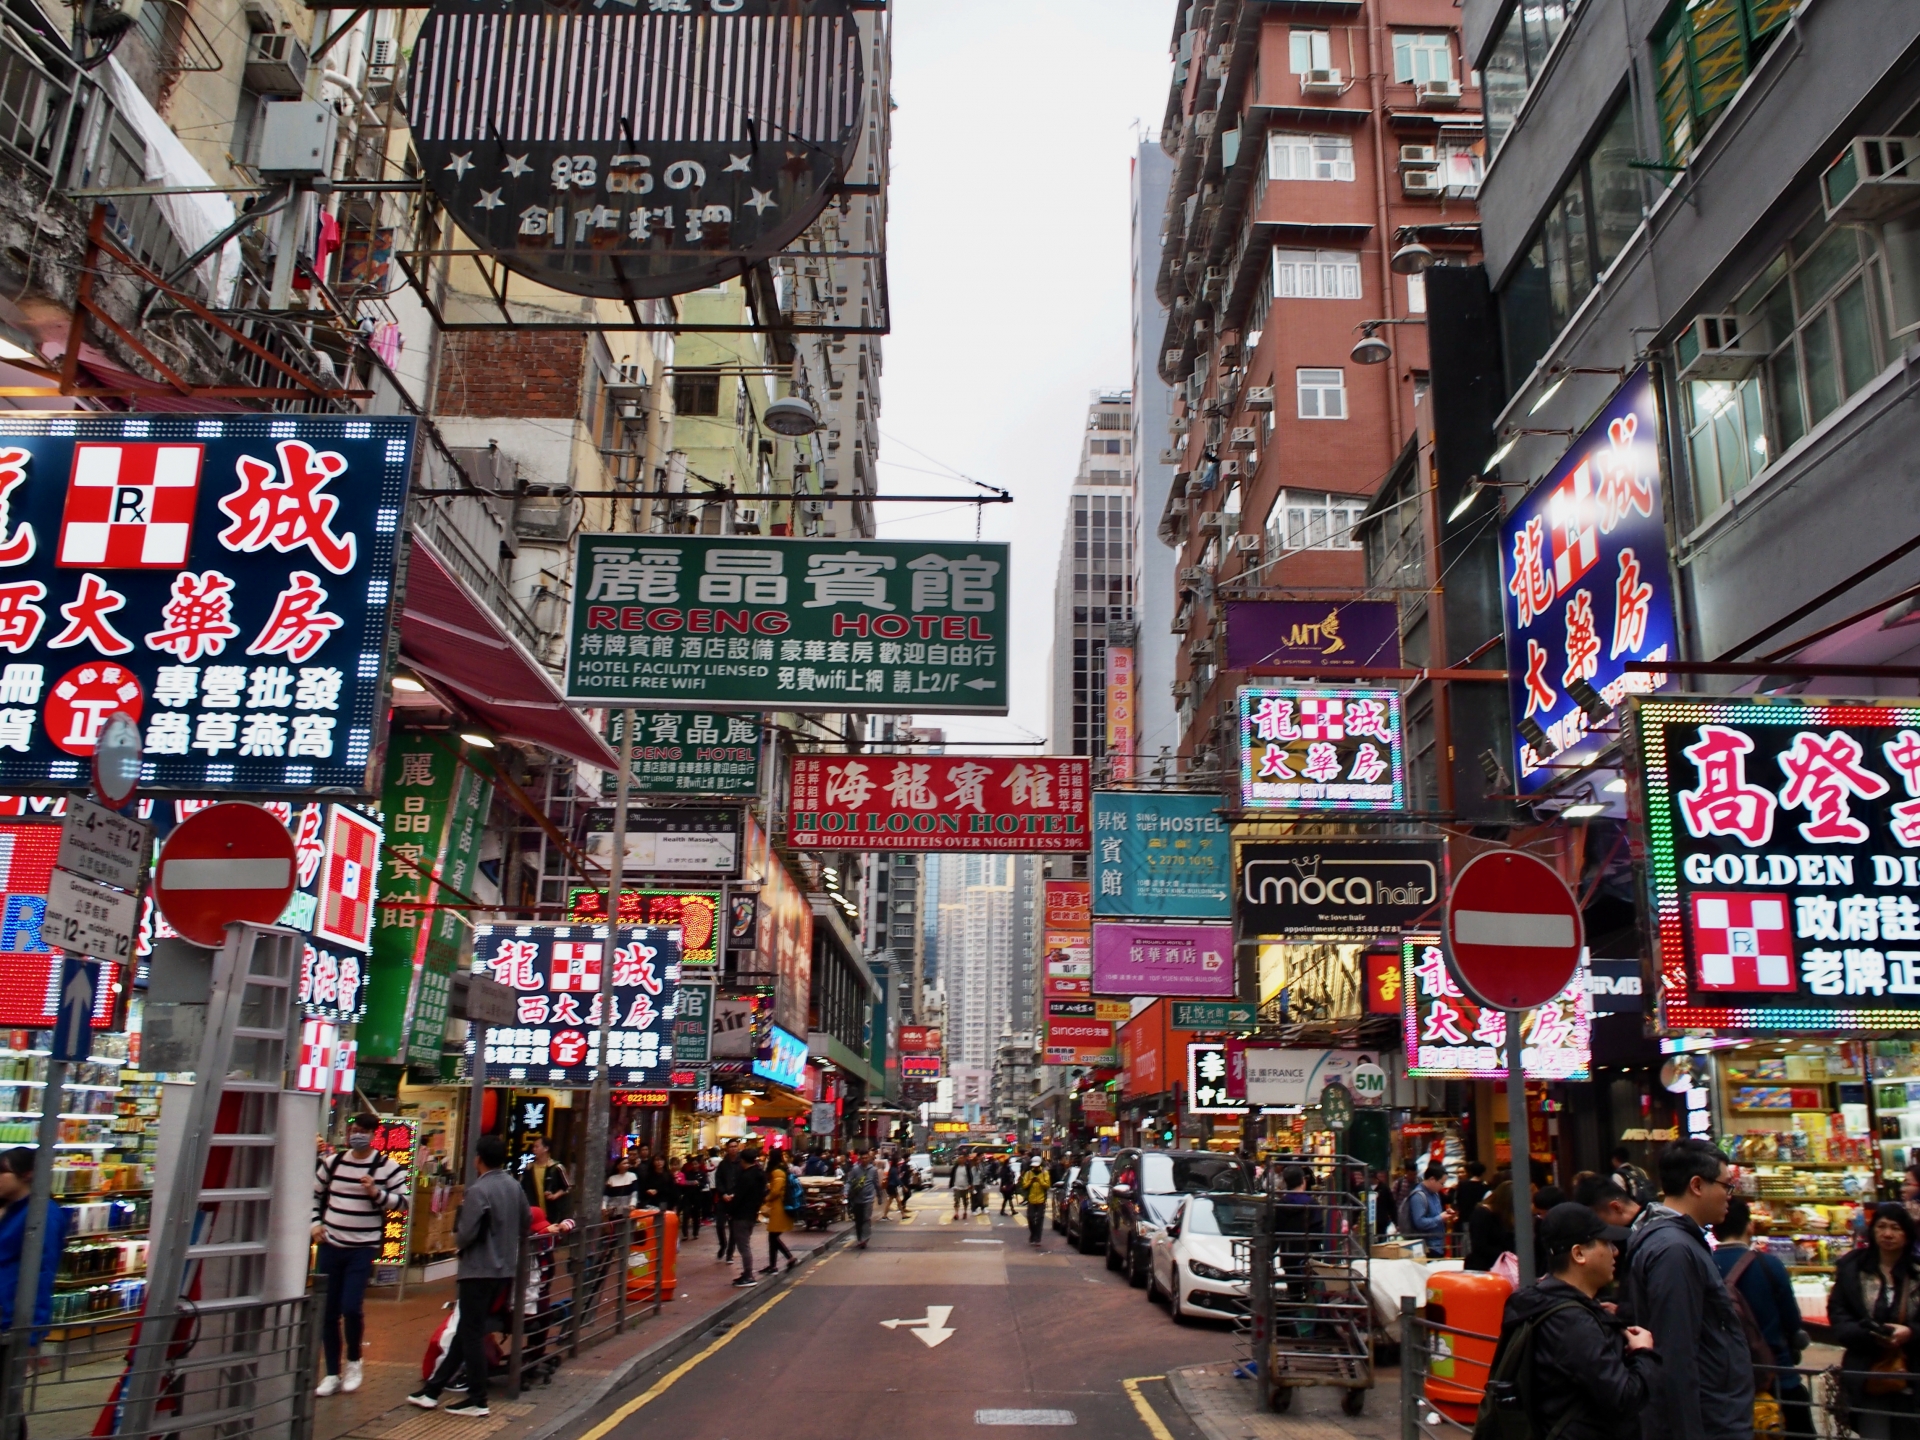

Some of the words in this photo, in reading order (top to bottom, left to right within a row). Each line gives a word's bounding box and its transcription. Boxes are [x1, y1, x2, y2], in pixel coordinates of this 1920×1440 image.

[218, 440, 356, 574] 城
[586, 547, 1000, 614] 麗晶賓館
[1510, 515, 1555, 630] 龍
[0, 570, 344, 664] 西大藥房
[587, 606, 791, 635] REGENG
[833, 612, 993, 641] HOTEL
[1524, 547, 1653, 718] 大藥房
[580, 633, 673, 661] 持牌賓館
[680, 636, 775, 662] 酒店設備
[780, 639, 876, 665] 豪華套房
[879, 641, 998, 668] 歡迎自由行
[578, 660, 629, 675] HOTEL
[633, 661, 701, 676] FACILITY
[704, 663, 769, 678] LIENSED
[578, 674, 627, 688] HOTEL
[631, 675, 668, 689] FREE
[672, 676, 706, 691] WIFI
[153, 665, 343, 711] 專營批發
[143, 711, 338, 758] 蟲草燕窩
[1251, 698, 1301, 740] 龍
[1344, 699, 1392, 744] 城
[697, 747, 756, 761] HOTEL
[1258, 742, 1388, 783] 大藥房
[825, 761, 1055, 813] 海龍賓館
[1678, 724, 1891, 848] 高登
[793, 812, 859, 831] HOI
[866, 812, 961, 833] LOON
[968, 813, 1084, 834] HOTEL
[1136, 813, 1158, 822] SING
[1136, 822, 1158, 831] YUET
[1160, 817, 1226, 833] HOSTEL
[381, 753, 436, 928] 麗晶賓館
[822, 836, 868, 846] HOTEL
[869, 836, 942, 847] FACILITEIS
[944, 837, 982, 848] OVER
[984, 837, 1027, 848] NIGHT
[1029, 837, 1062, 848] LESS
[1064, 838, 1083, 848] 20%
[1159, 855, 1185, 866] 2770
[1188, 855, 1214, 866] 1015
[1683, 853, 1855, 886] GOLDEN
[1259, 876, 1373, 905] moca
[1376, 880, 1425, 905] hair
[1284, 925, 1336, 934] appointment
[1356, 925, 1379, 933] 2388
[1318, 913, 1331, 921] We
[1332, 913, 1348, 921] love
[1349, 913, 1367, 921] hair
[115, 932, 130, 956] 12
[487, 939, 545, 990] 龍
[1051, 1026, 1094, 1036] sincere
[1267, 1068, 1304, 1078] FRANCE
[1356, 1073, 1384, 1091] 5M
